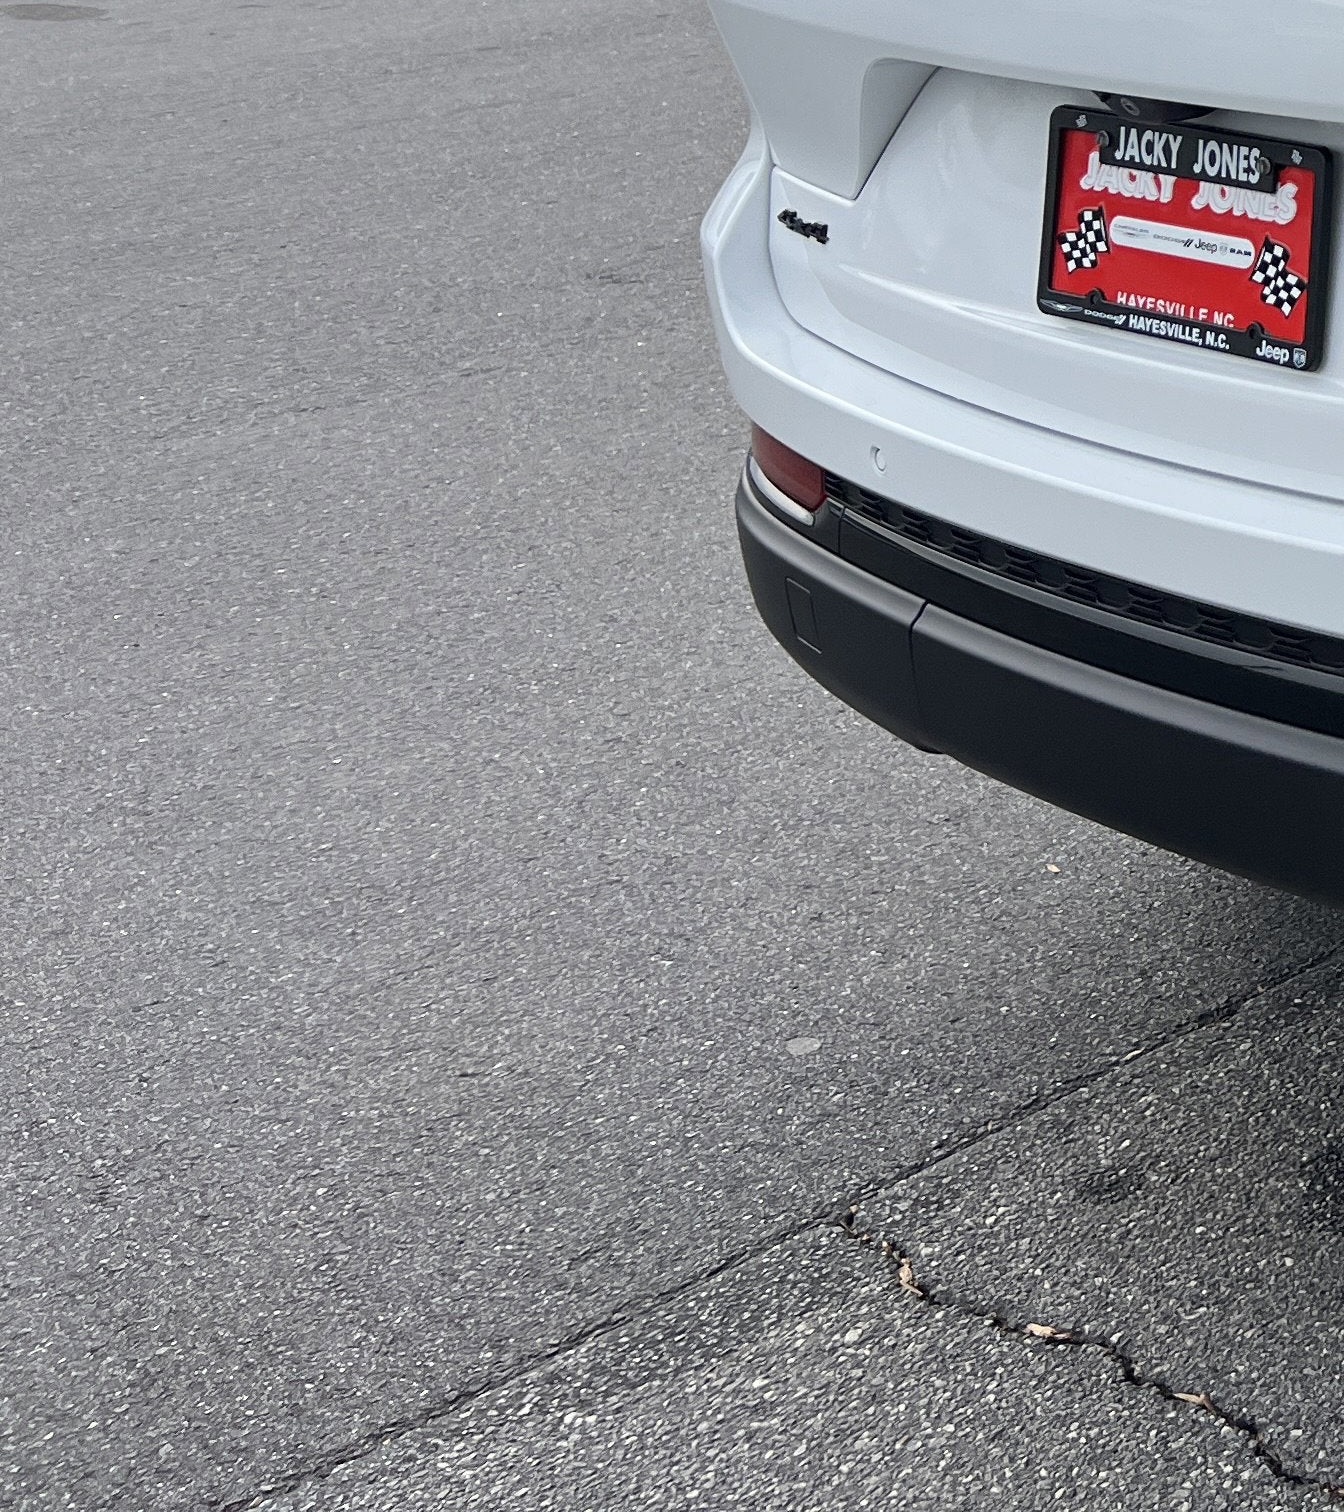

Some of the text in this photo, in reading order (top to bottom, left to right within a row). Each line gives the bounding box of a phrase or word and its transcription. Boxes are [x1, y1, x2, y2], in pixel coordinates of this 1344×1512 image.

[1114, 125, 1262, 184] JACKY JONES
[1080, 151, 1299, 226] JACKY JONES
[1194, 238, 1218, 254] Jeep
[1128, 313, 1203, 346] HAYESVILLE,
[1205, 330, 1230, 350] N.C.
[1255, 339, 1290, 365] Jeep
